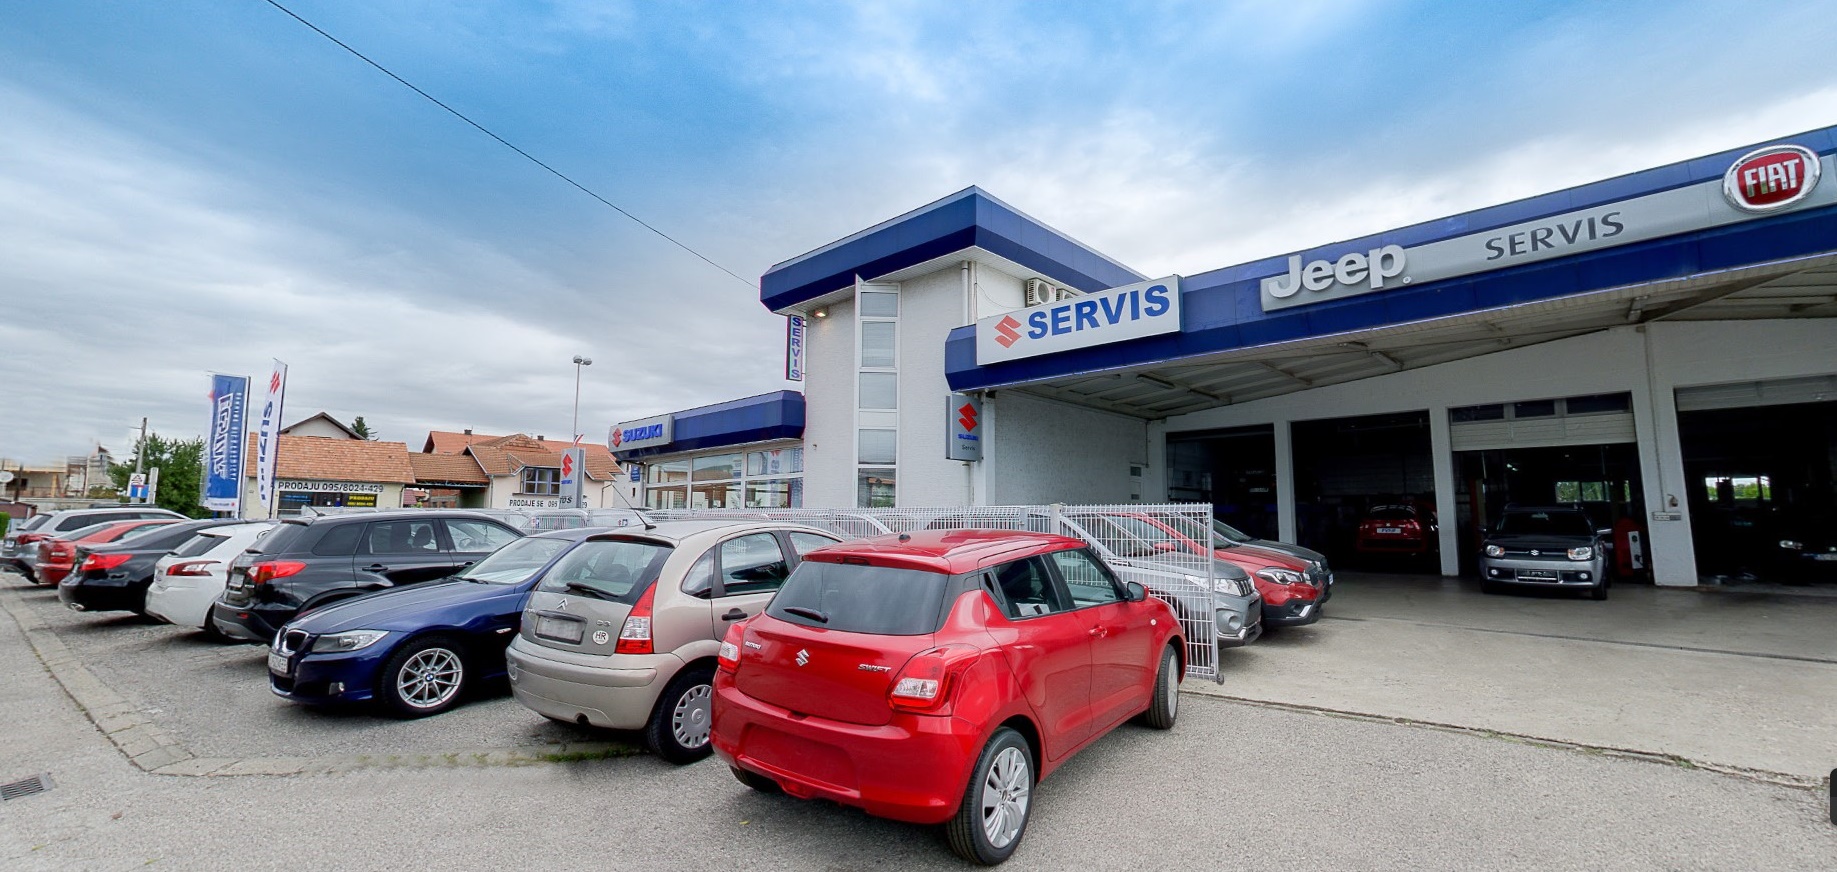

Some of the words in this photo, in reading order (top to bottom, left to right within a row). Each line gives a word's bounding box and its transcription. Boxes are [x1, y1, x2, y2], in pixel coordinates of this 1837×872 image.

[1744, 158, 1800, 198] FIAT
[1485, 212, 1624, 260] SERVIS
[1268, 244, 1406, 298] Jeep
[1027, 284, 1170, 340] SERVIS
[791, 317, 802, 378] SERVIS
[623, 424, 663, 442] SUZUKI
[278, 481, 320, 491] PRODAJU
[509, 499, 535, 507] PRODAJE
[595, 631, 607, 640] HR
[857, 663, 892, 673] SWIFT
